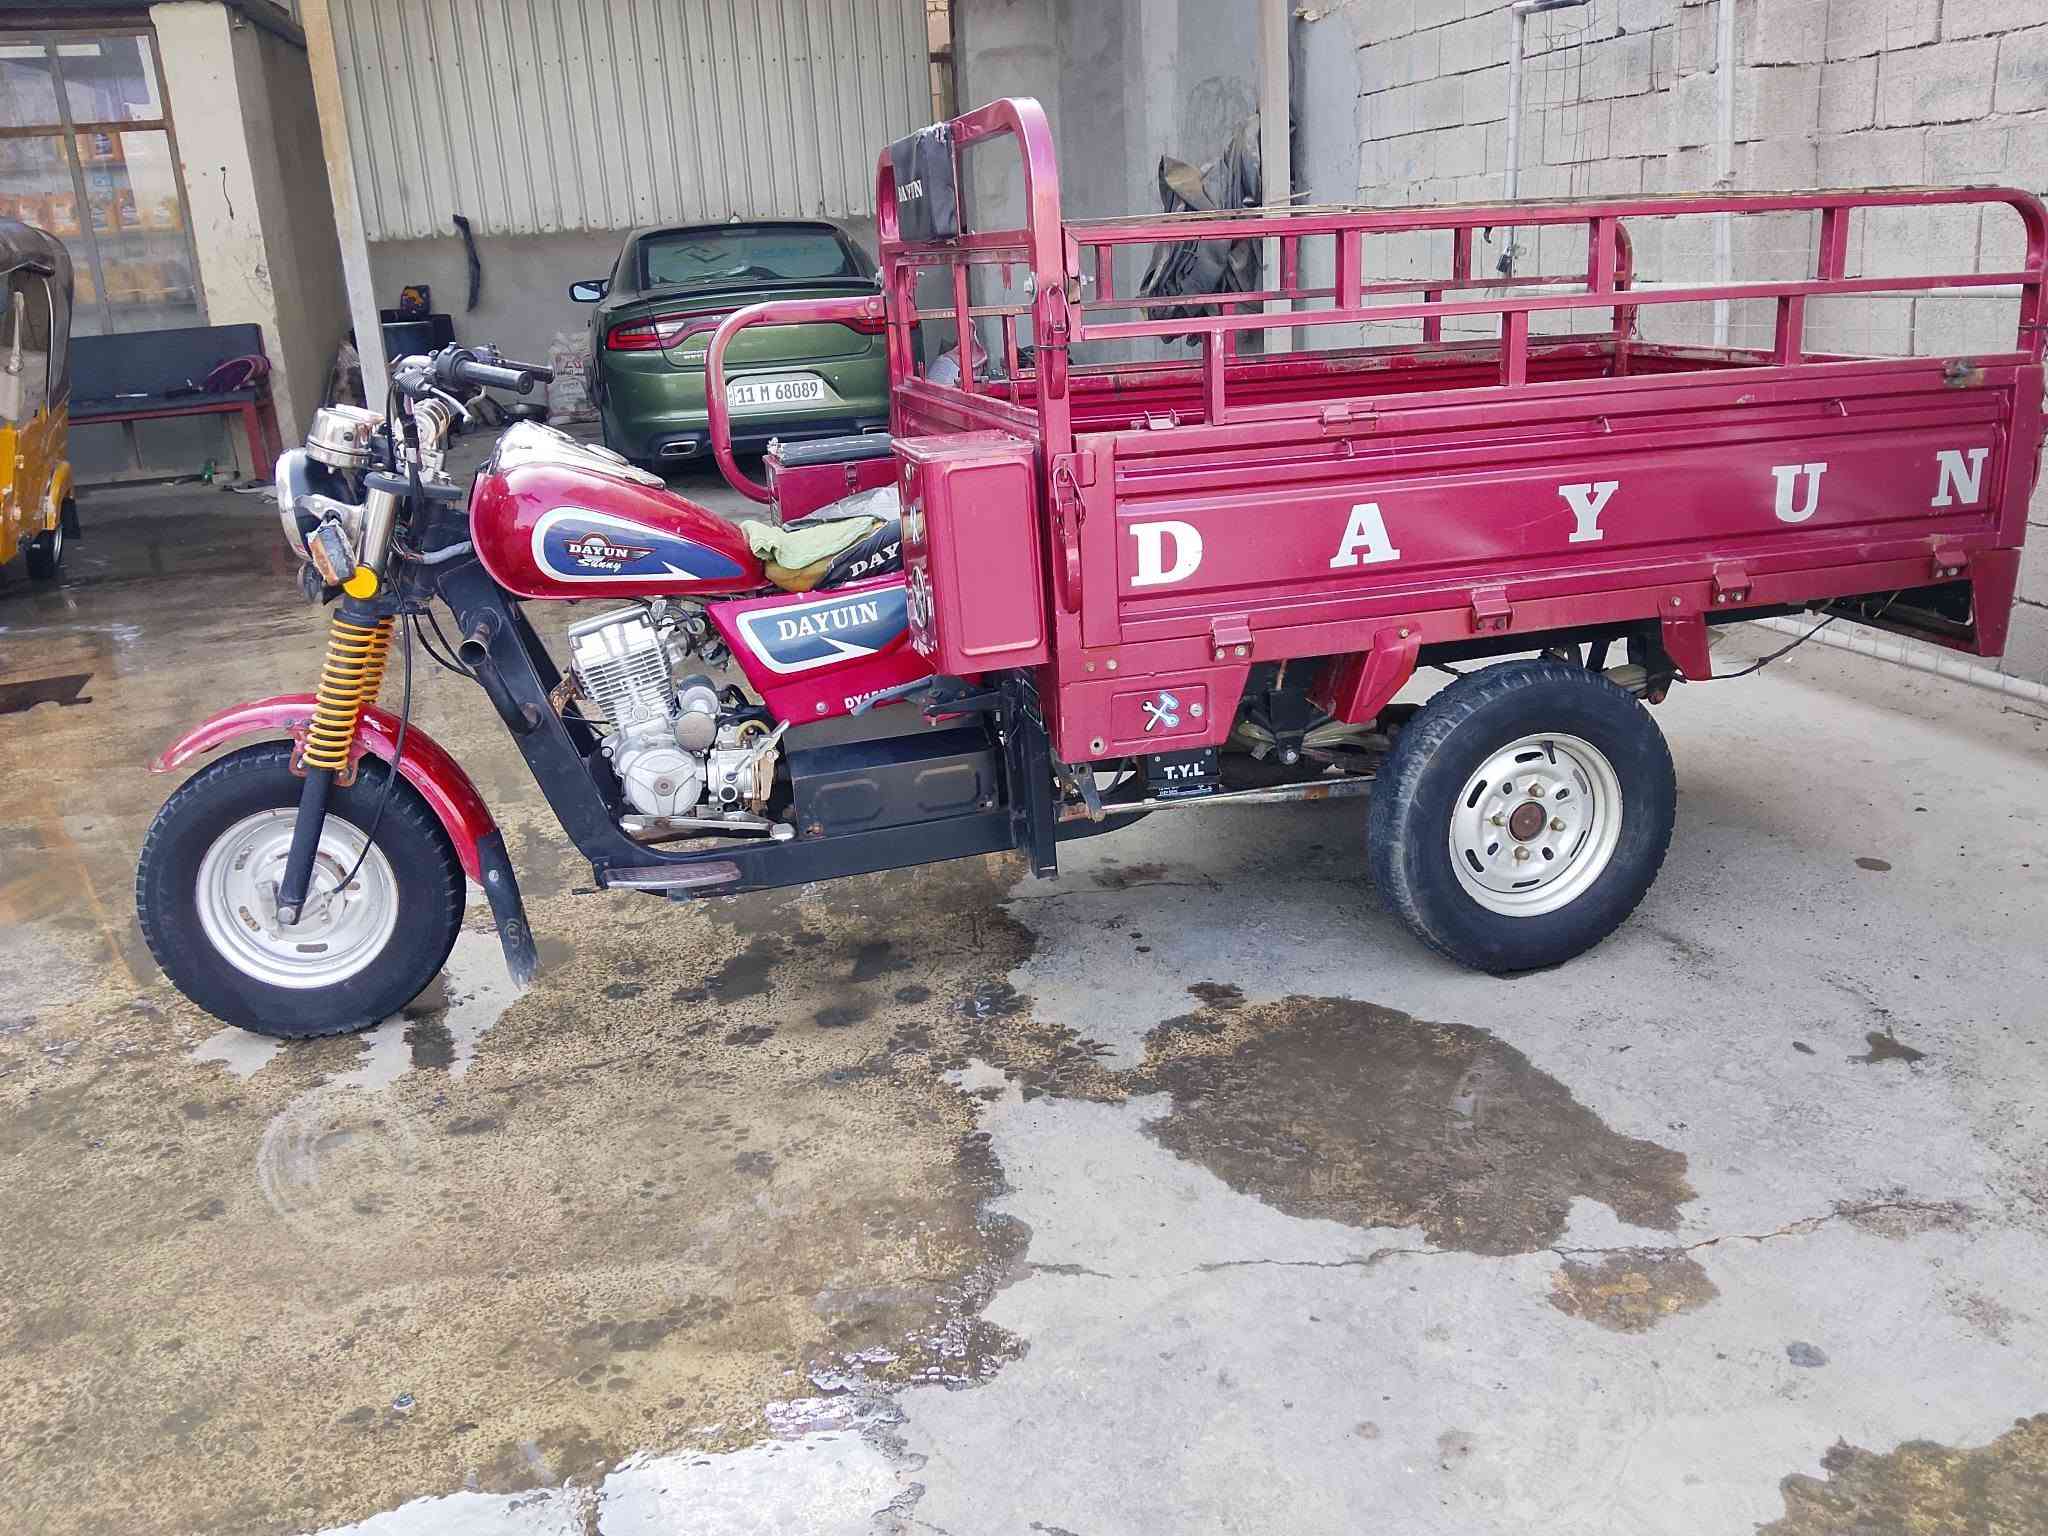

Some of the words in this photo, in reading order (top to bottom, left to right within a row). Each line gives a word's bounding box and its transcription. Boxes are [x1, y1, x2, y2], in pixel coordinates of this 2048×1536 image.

[737, 387, 755, 403] 11
[760, 385, 770, 401] M
[775, 382, 818, 400] 68089
[569, 543, 628, 558] DAYUN
[576, 558, 623, 574] Sunny
[777, 601, 879, 641] DAYUIN
